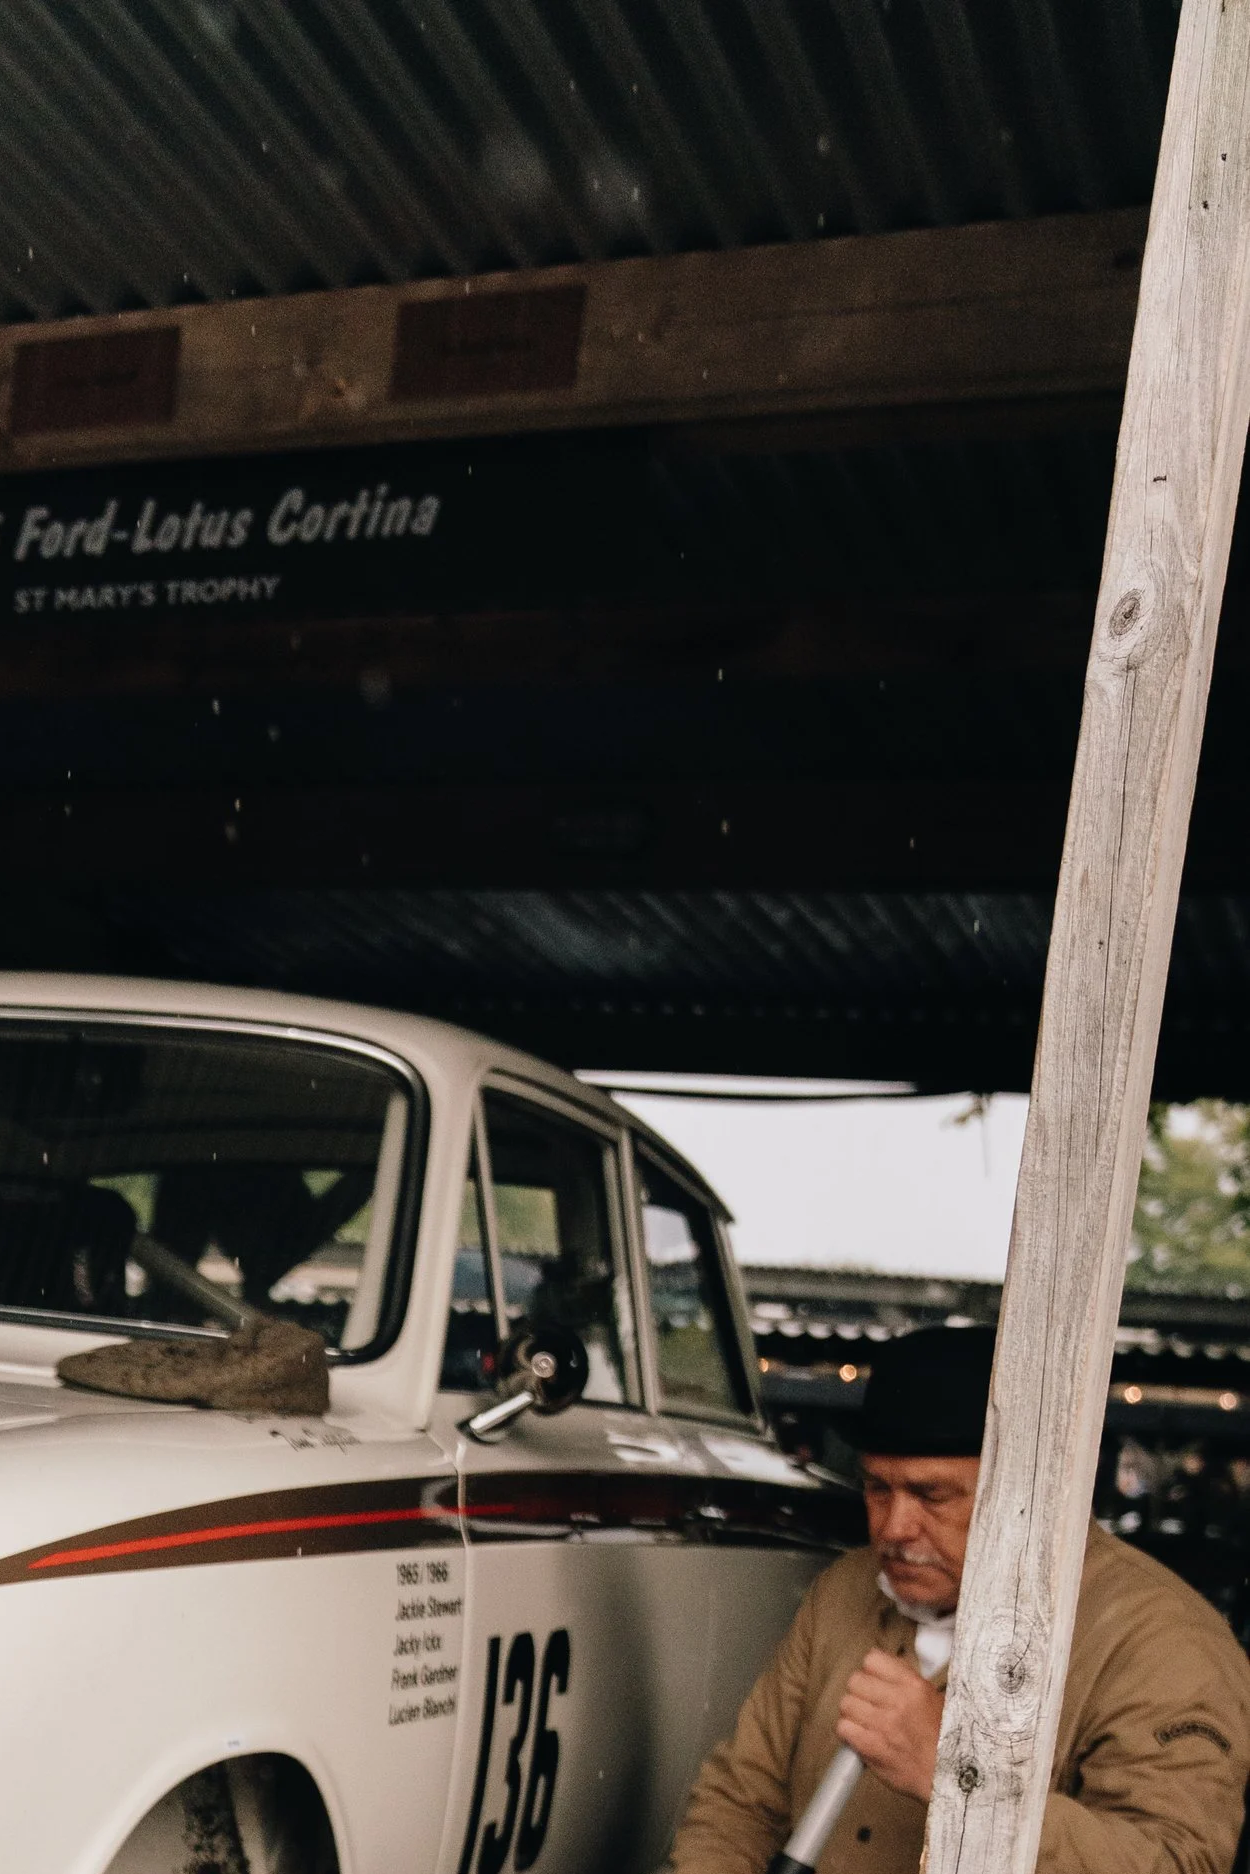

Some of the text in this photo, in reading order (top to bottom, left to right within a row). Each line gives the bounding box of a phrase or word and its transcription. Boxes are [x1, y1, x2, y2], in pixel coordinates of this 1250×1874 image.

[14, 498, 254, 562] Ford-Lotus
[267, 483, 442, 546] Cortina
[13, 575, 282, 613] ST MARY'S TROPHY
[395, 1595, 463, 1621] Jackie Stewart
[391, 1662, 457, 1691] Frank Gardner
[389, 1699, 421, 1727] Lucien
